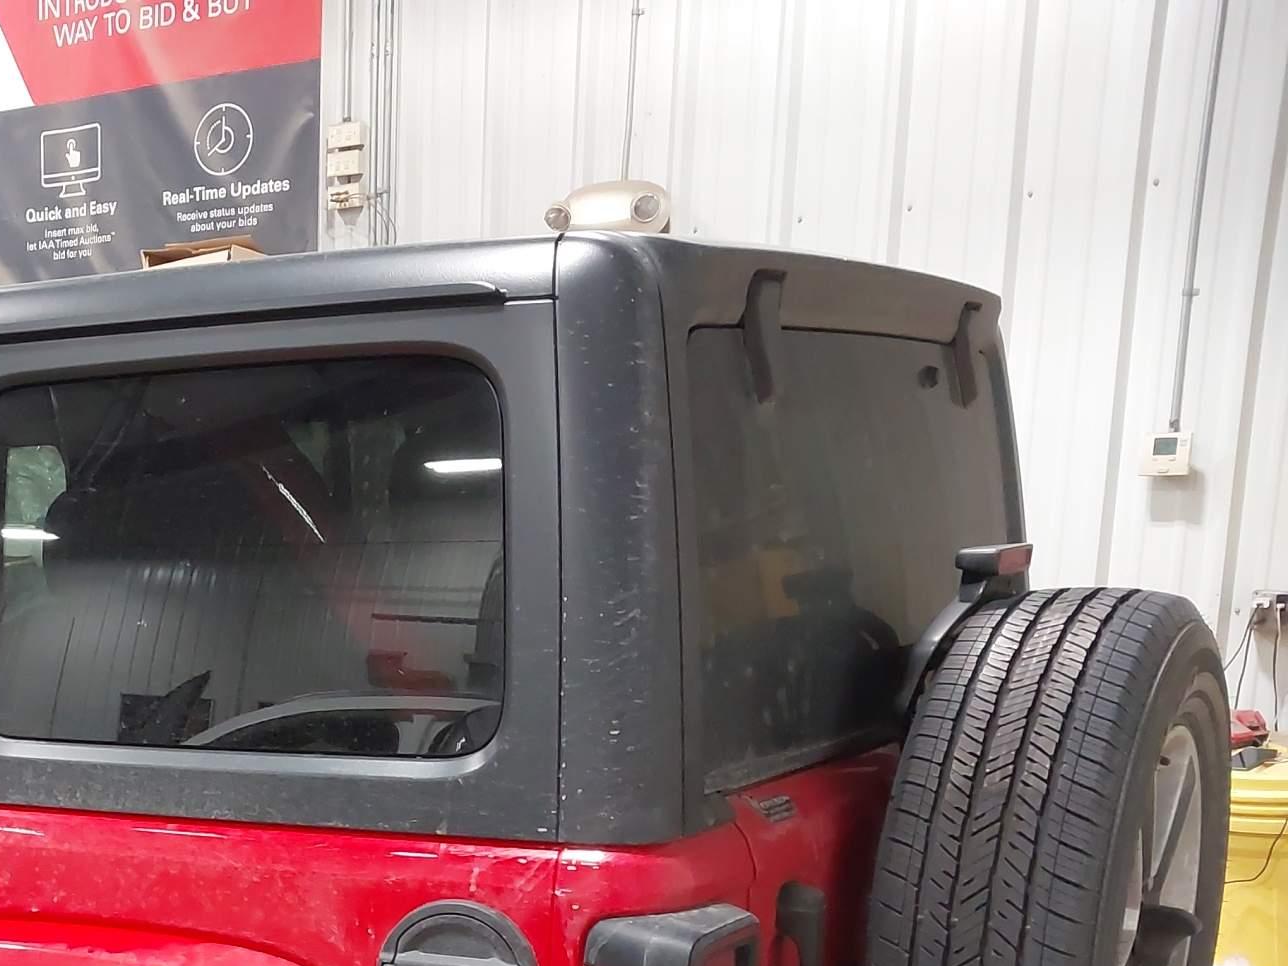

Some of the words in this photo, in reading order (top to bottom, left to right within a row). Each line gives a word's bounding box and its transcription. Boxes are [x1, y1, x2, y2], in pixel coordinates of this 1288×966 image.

[53, 16, 98, 48] WAY
[103, 9, 131, 37] TO
[139, 2, 176, 30] BID
[182, 0, 200, 22] &
[162, 186, 226, 206] Real-Time
[230, 179, 290, 199] Updates
[25, 206, 62, 223] Quick
[65, 203, 87, 219] and
[90, 200, 117, 216] Easy
[177, 210, 208, 222] Receive
[209, 207, 235, 218] status
[238, 203, 273, 216] updates
[44, 228, 67, 239] Insert
[68, 227, 85, 236] max
[191, 221, 214, 233] about
[216, 220, 236, 231] your
[238, 216, 258, 227] bids
[26, 241, 37, 251] let
[39, 240, 55, 250] IAA
[55, 237, 79, 249] Timed
[53, 250, 65, 260] bid
[67, 249, 77, 259] for
[78, 248, 92, 259] you
